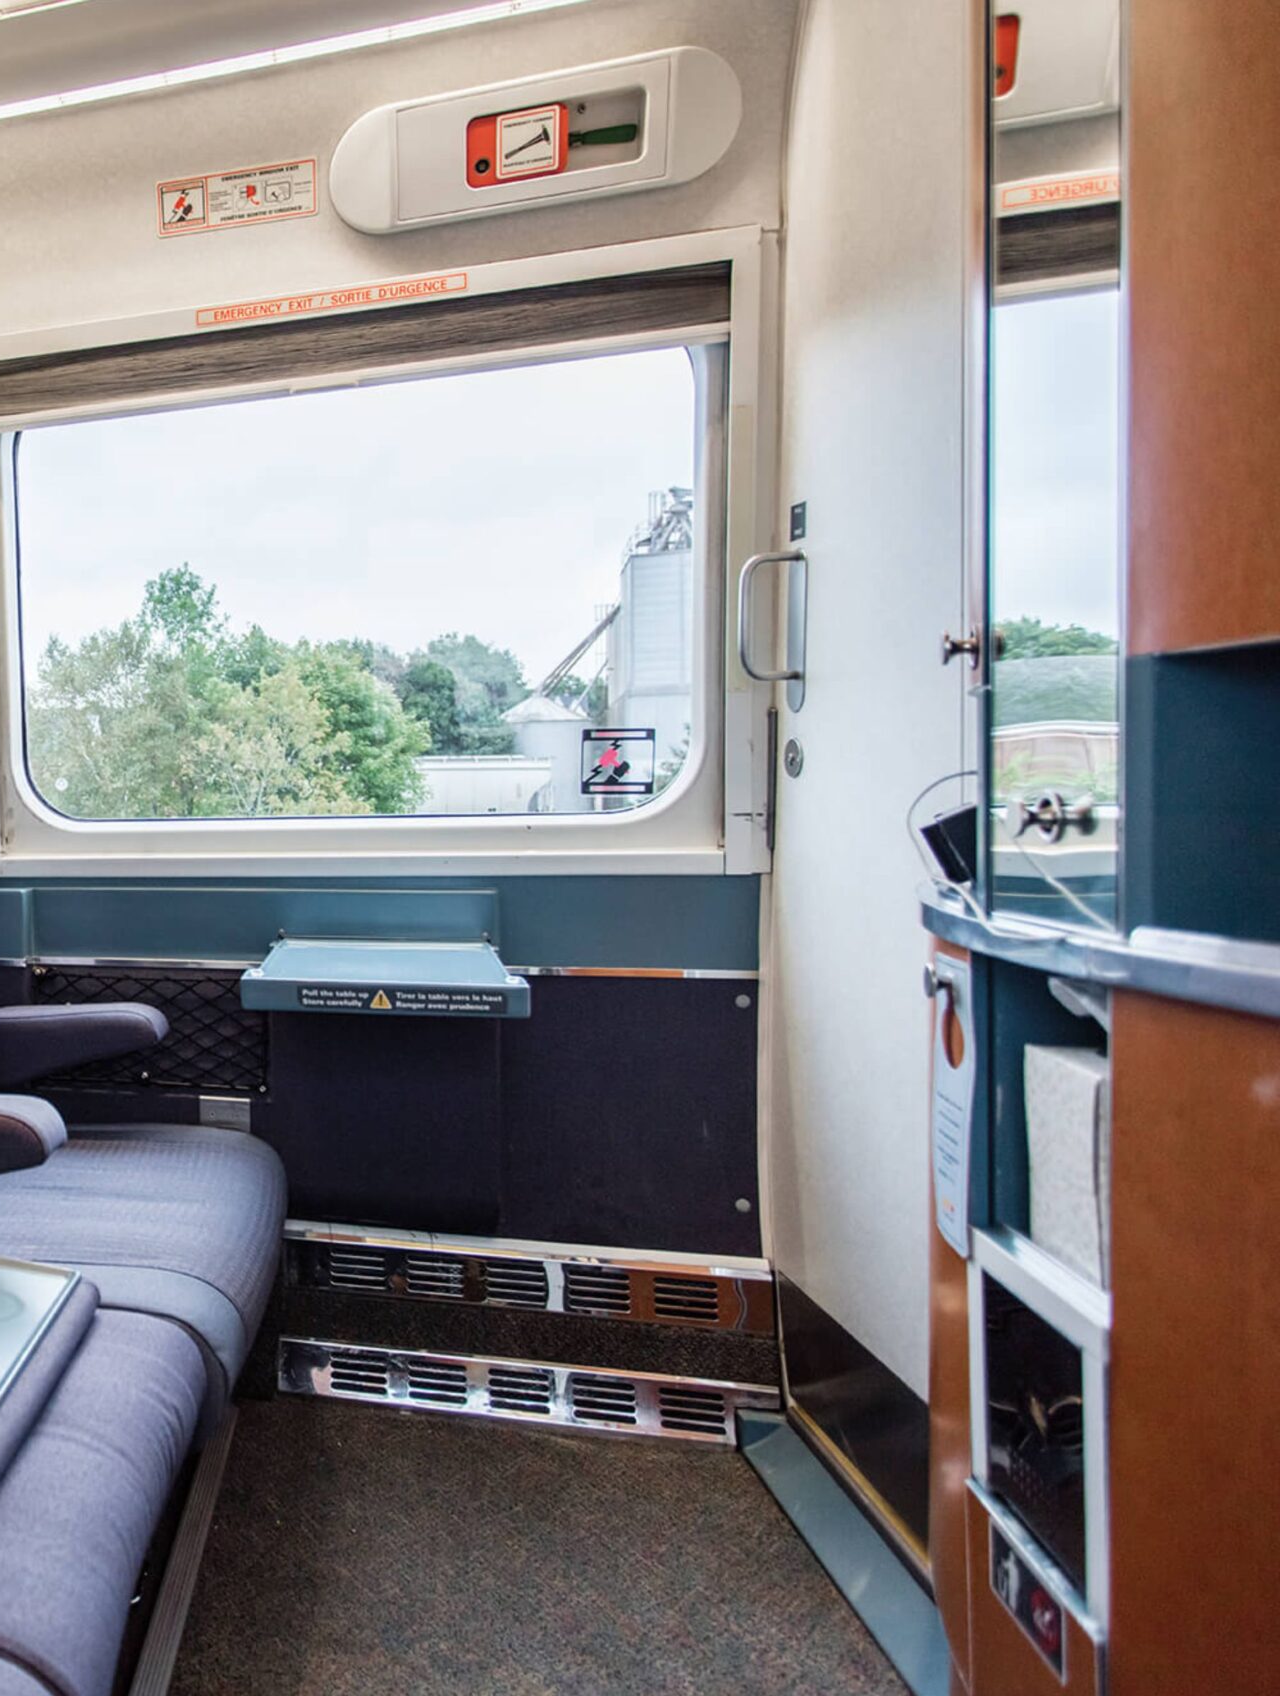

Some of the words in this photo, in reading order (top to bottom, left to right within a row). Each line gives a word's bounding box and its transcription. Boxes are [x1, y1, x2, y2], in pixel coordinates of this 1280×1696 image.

[213, 303, 282, 321] EMERGENCY
[288, 298, 313, 311] EXIT
[331, 290, 372, 305] SORTIE
[378, 280, 448, 298] D'URGENCE
[302, 989, 318, 997] Pull
[335, 990, 357, 998] table
[395, 991, 416, 999] Tirer
[417, 992, 426, 1000] la
[428, 992, 449, 1000] table
[482, 994, 503, 1002] haut
[302, 997, 325, 1006] Store
[326, 999, 363, 1008] carefully
[395, 1000, 426, 1010] Ranger
[449, 1003, 491, 1011] prudence
